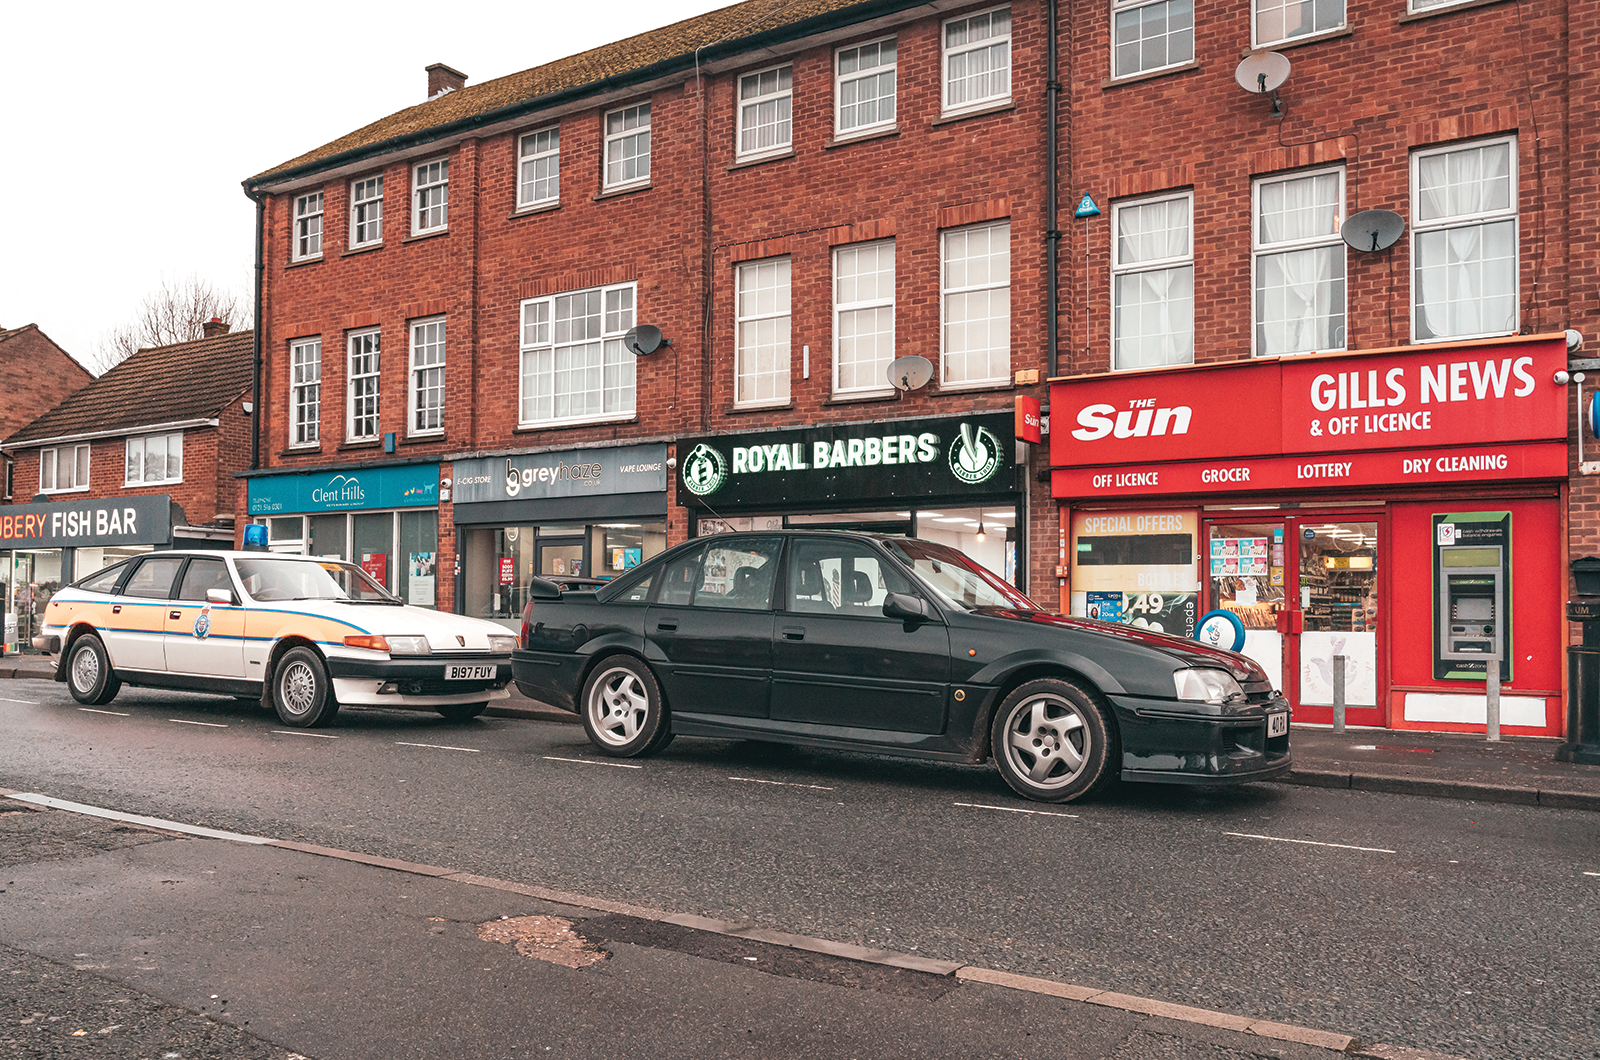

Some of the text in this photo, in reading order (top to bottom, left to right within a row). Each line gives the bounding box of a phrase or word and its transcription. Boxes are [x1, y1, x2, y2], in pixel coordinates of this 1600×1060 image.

[1310, 356, 1536, 412] GILLS NEWS
[1129, 398, 1157, 409] THE
[1071, 403, 1193, 442] Sun
[1309, 411, 1432, 437] & OFF LICENCE
[732, 432, 938, 474] ROYAL BARBERS
[620, 462, 662, 473] VAPE LOUNGE
[1297, 462, 1353, 479] LOTTERY
[1403, 454, 1508, 474] DRY CLEANING
[1092, 472, 1159, 488] OFF LICENCE
[1201, 467, 1251, 483] GROCER
[312, 485, 366, 503] Clent Hills
[52, 510, 91, 538] FISH
[96, 507, 137, 536] BAR
[1085, 515, 1183, 533] SPECIAL OFFERS
[451, 666, 492, 678] B197 FUY
